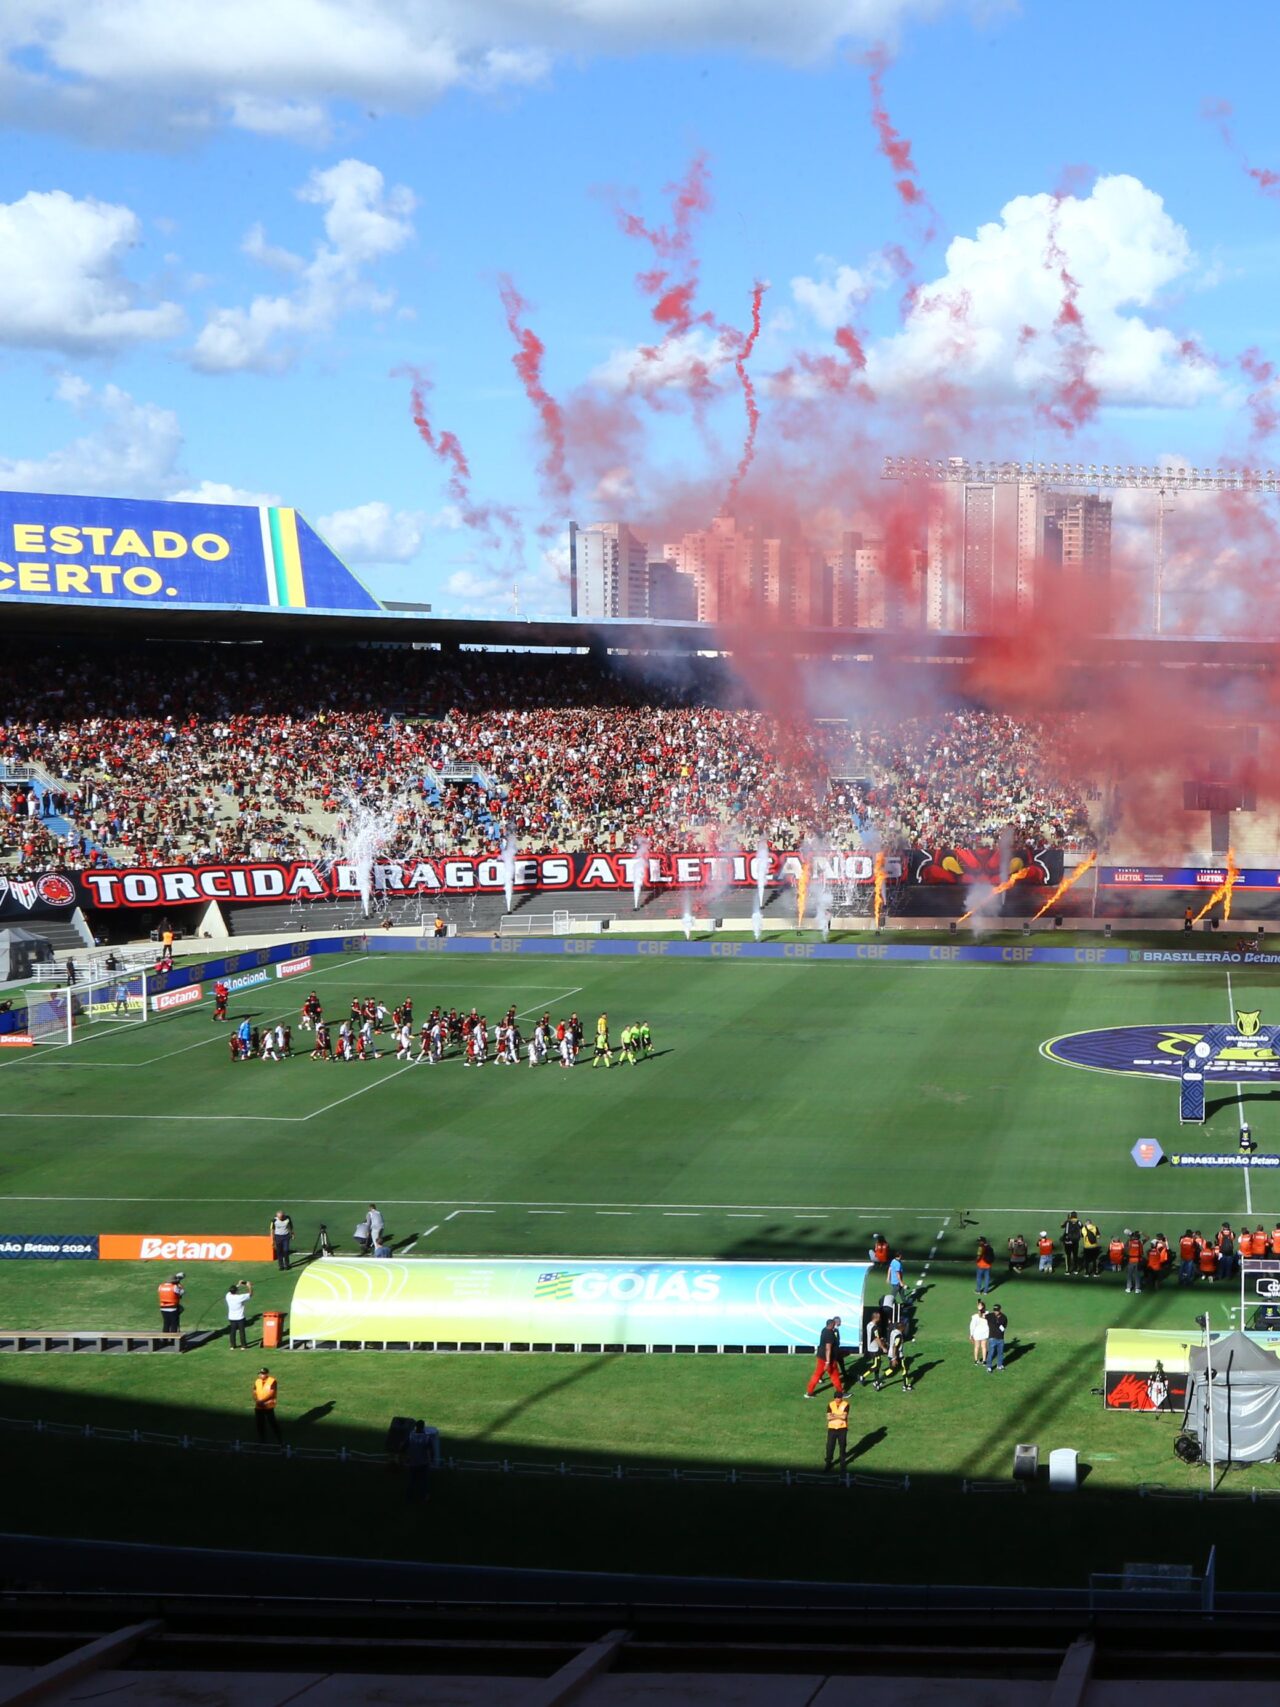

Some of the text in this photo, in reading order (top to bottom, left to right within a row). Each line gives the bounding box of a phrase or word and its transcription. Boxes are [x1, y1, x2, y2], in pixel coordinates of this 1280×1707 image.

[13, 523, 231, 561] ESTADO
[88, 867, 324, 903] TORCIDA
[1197, 875, 1224, 883] LUZTOL
[291, 942, 309, 956] CBF
[416, 937, 448, 950] CBF
[491, 939, 522, 951] CBF
[564, 940, 595, 953] CBF
[637, 940, 669, 954] CBF
[710, 942, 742, 956] CBF
[783, 943, 815, 957] CBF
[857, 945, 888, 958] CBF
[929, 946, 960, 959] CBF
[1002, 947, 1033, 961] CBF
[1074, 948, 1105, 962] CBF
[1143, 951, 1241, 962] BRASILEIRÃO
[159, 989, 199, 1008] Betano
[1181, 1156, 1249, 1165] BRASILEIRÃO
[1251, 1156, 1279, 1165] Betano
[24, 1243, 59, 1252] Betano
[63, 1244, 92, 1253] 2024
[140, 1238, 233, 1259] Betano
